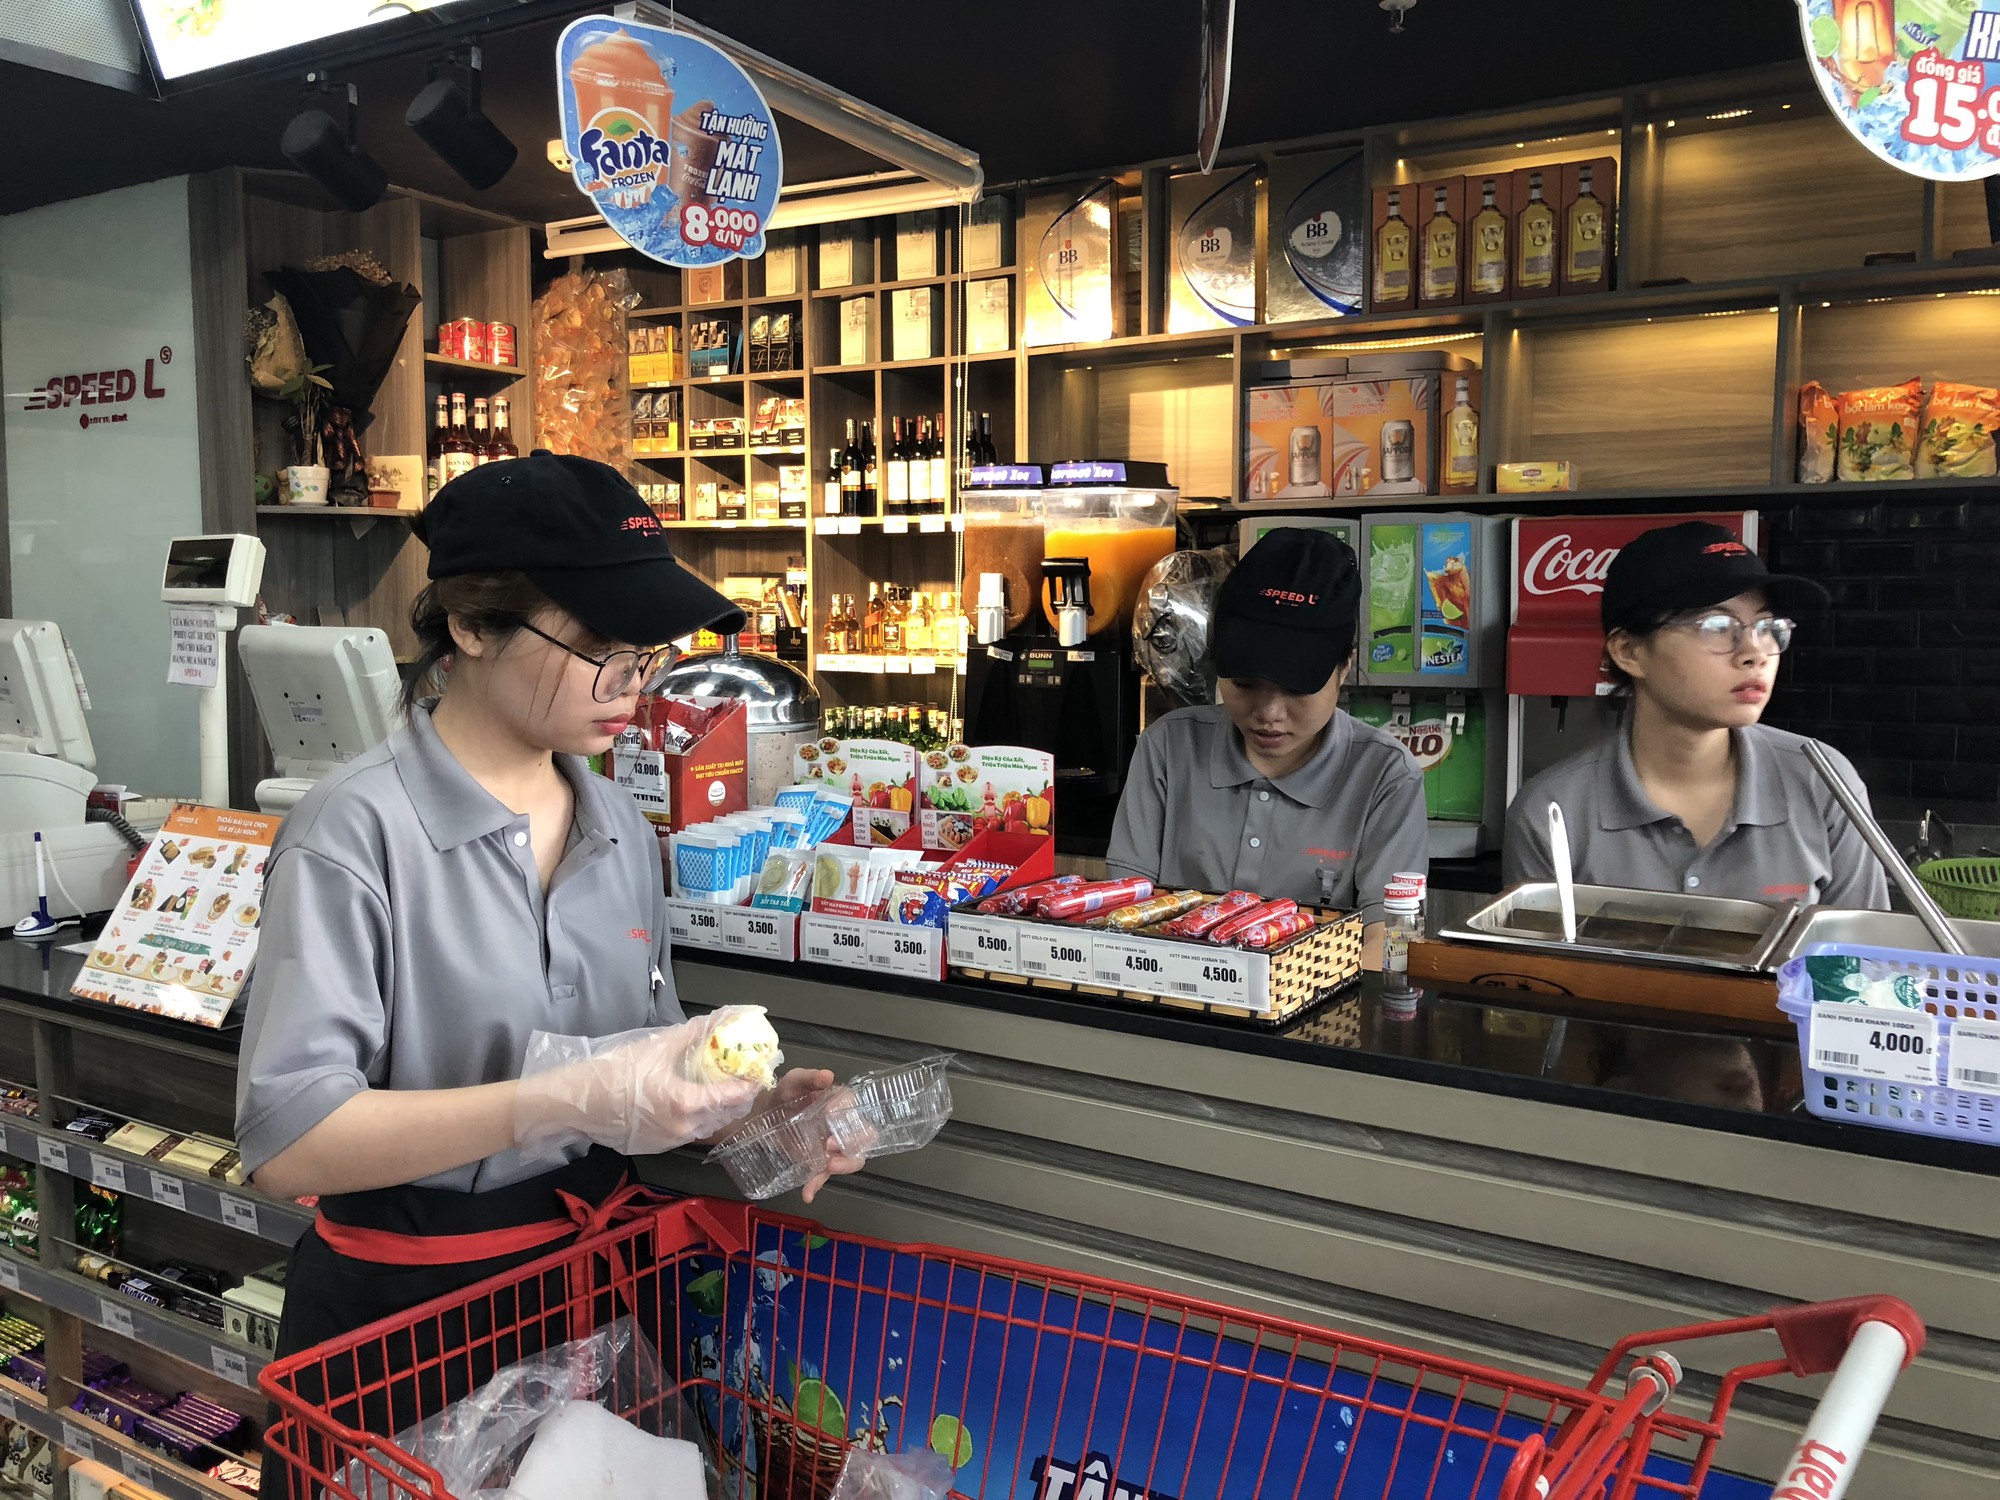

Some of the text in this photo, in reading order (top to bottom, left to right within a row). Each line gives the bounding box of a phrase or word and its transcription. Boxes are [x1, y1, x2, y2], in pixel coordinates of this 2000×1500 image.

[1957, 61, 1981, 84] giá
[701, 109, 768, 140] TẬN HƯỞNG
[580, 128, 670, 180] Fanta
[715, 138, 762, 171] MÁT
[611, 171, 655, 188] FROZEN
[706, 169, 760, 203] LẠNH
[685, 205, 757, 242] 8.000
[1307, 223, 1328, 238] BB
[715, 231, 743, 247] đ/ly
[1201, 238, 1220, 253] BB
[1059, 249, 1078, 264] BB
[47, 358, 166, 409] SPEED L
[1265, 588, 1316, 605] SPEED L
[1427, 653, 1463, 666] NESTEA
[1409, 724, 1441, 735] Nestlé
[634, 763, 659, 776] 13,000
[902, 875, 914, 883] MUA
[916, 876, 922, 884] 4
[691, 914, 715, 927] 3,500
[748, 921, 773, 935] 3,500
[833, 933, 860, 948] 3,500
[894, 940, 923, 955] 3,500
[978, 936, 1007, 952] 8,500
[1051, 946, 1082, 962] 5,000
[1126, 956, 1158, 973] 4,500
[1203, 966, 1237, 983] 4,500
[1838, 1015, 1853, 1023] PHO
[1865, 1018, 1890, 1027] KHANH
[1869, 1030, 1924, 1055] 4,000
